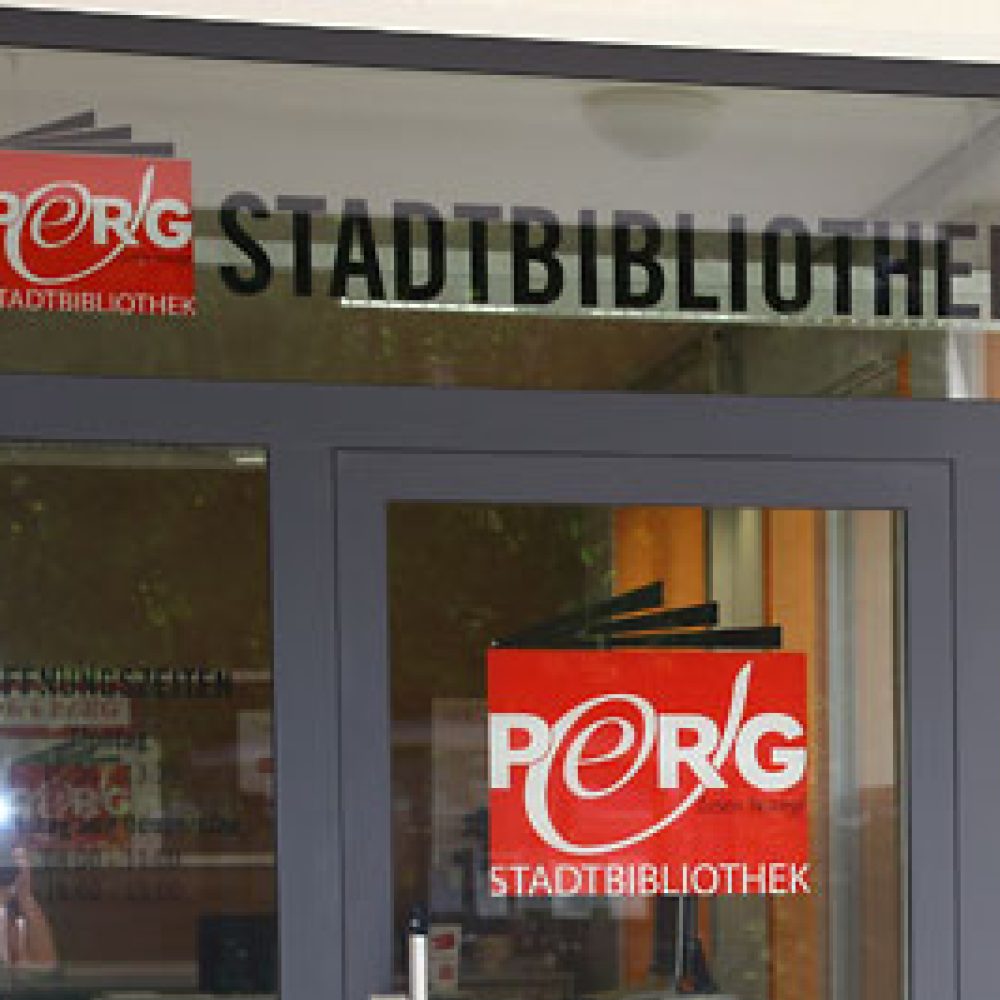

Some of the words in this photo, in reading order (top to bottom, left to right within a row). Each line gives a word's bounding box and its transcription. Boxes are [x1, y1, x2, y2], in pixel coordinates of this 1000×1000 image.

[0, 287, 197, 317] TADTBIBLIOTHEK
[0, 667, 232, 698] FFNUNGSZEITEN
[490, 862, 811, 898] STADTBIBLIOTHEK
